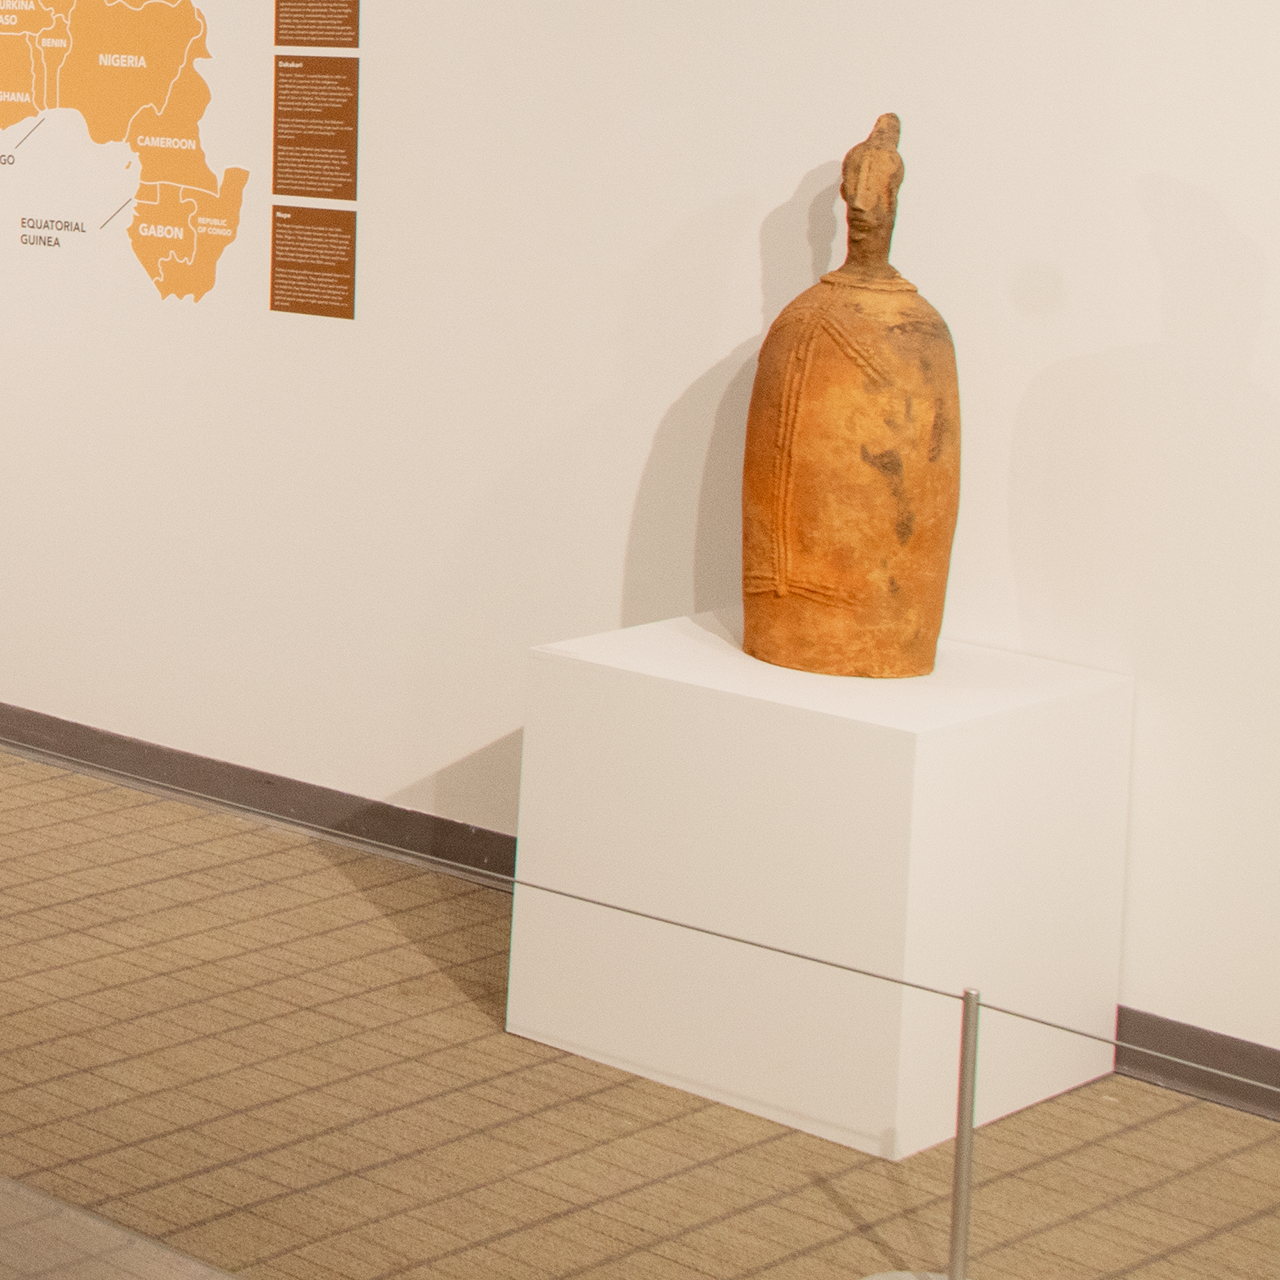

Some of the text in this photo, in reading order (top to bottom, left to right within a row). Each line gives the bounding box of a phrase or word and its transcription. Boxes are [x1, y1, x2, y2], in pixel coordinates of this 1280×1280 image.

[41, 38, 67, 48] BENIN
[99, 54, 146, 67] NIGERIA
[137, 135, 197, 151] CAMEROON
[20, 218, 86, 233] EQUATORIAL
[139, 223, 183, 239] GABON
[207, 227, 232, 236] CONGO
[21, 234, 60, 247] GUINEA
